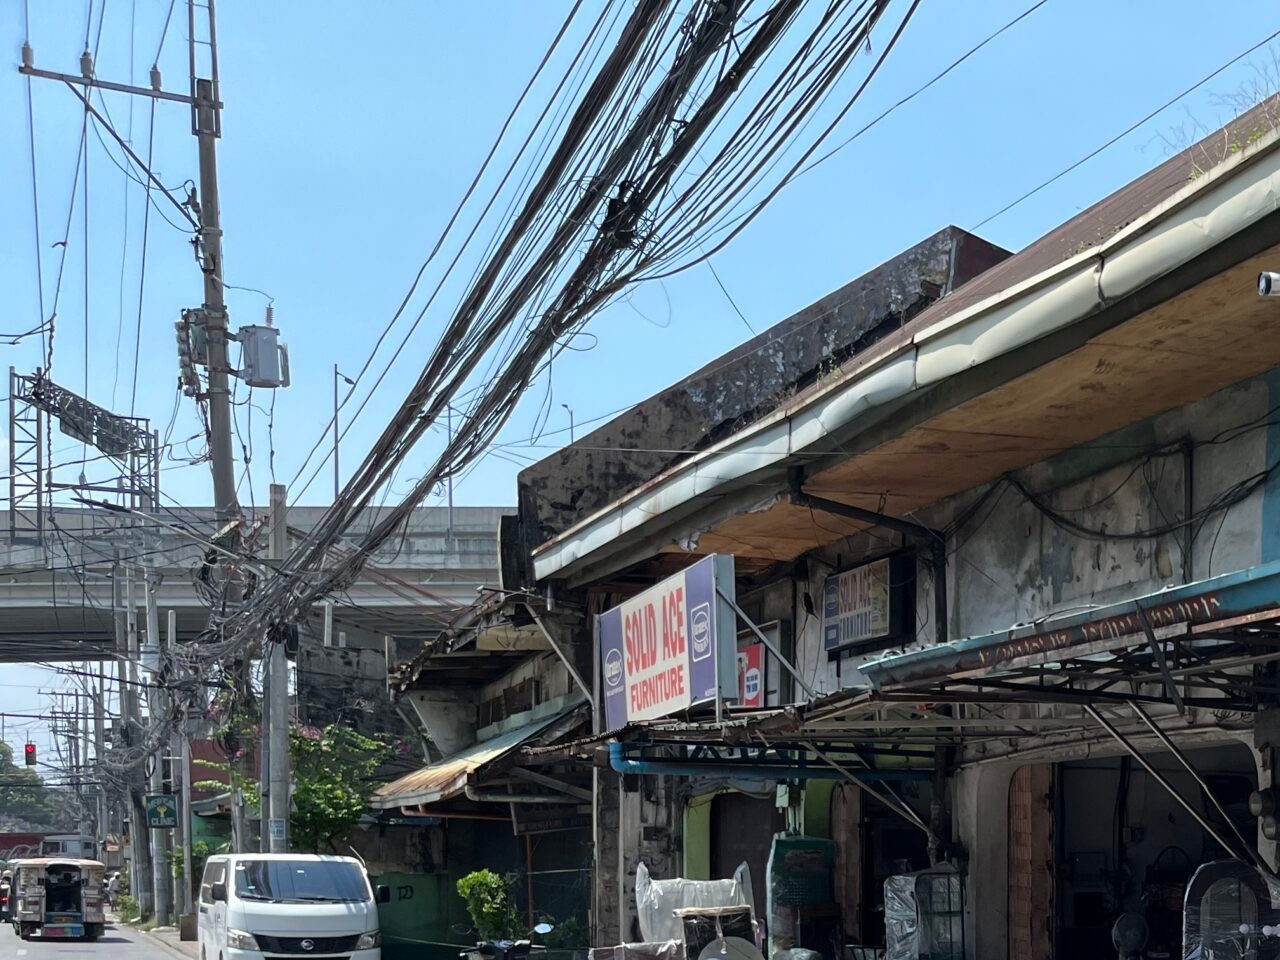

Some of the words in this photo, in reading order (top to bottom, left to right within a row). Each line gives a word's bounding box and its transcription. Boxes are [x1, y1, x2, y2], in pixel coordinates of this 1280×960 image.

[625, 602, 658, 677] SOLID
[662, 587, 686, 661] ACE
[630, 664, 685, 713] FURNITURE
[151, 817, 175, 826] CLINIC
